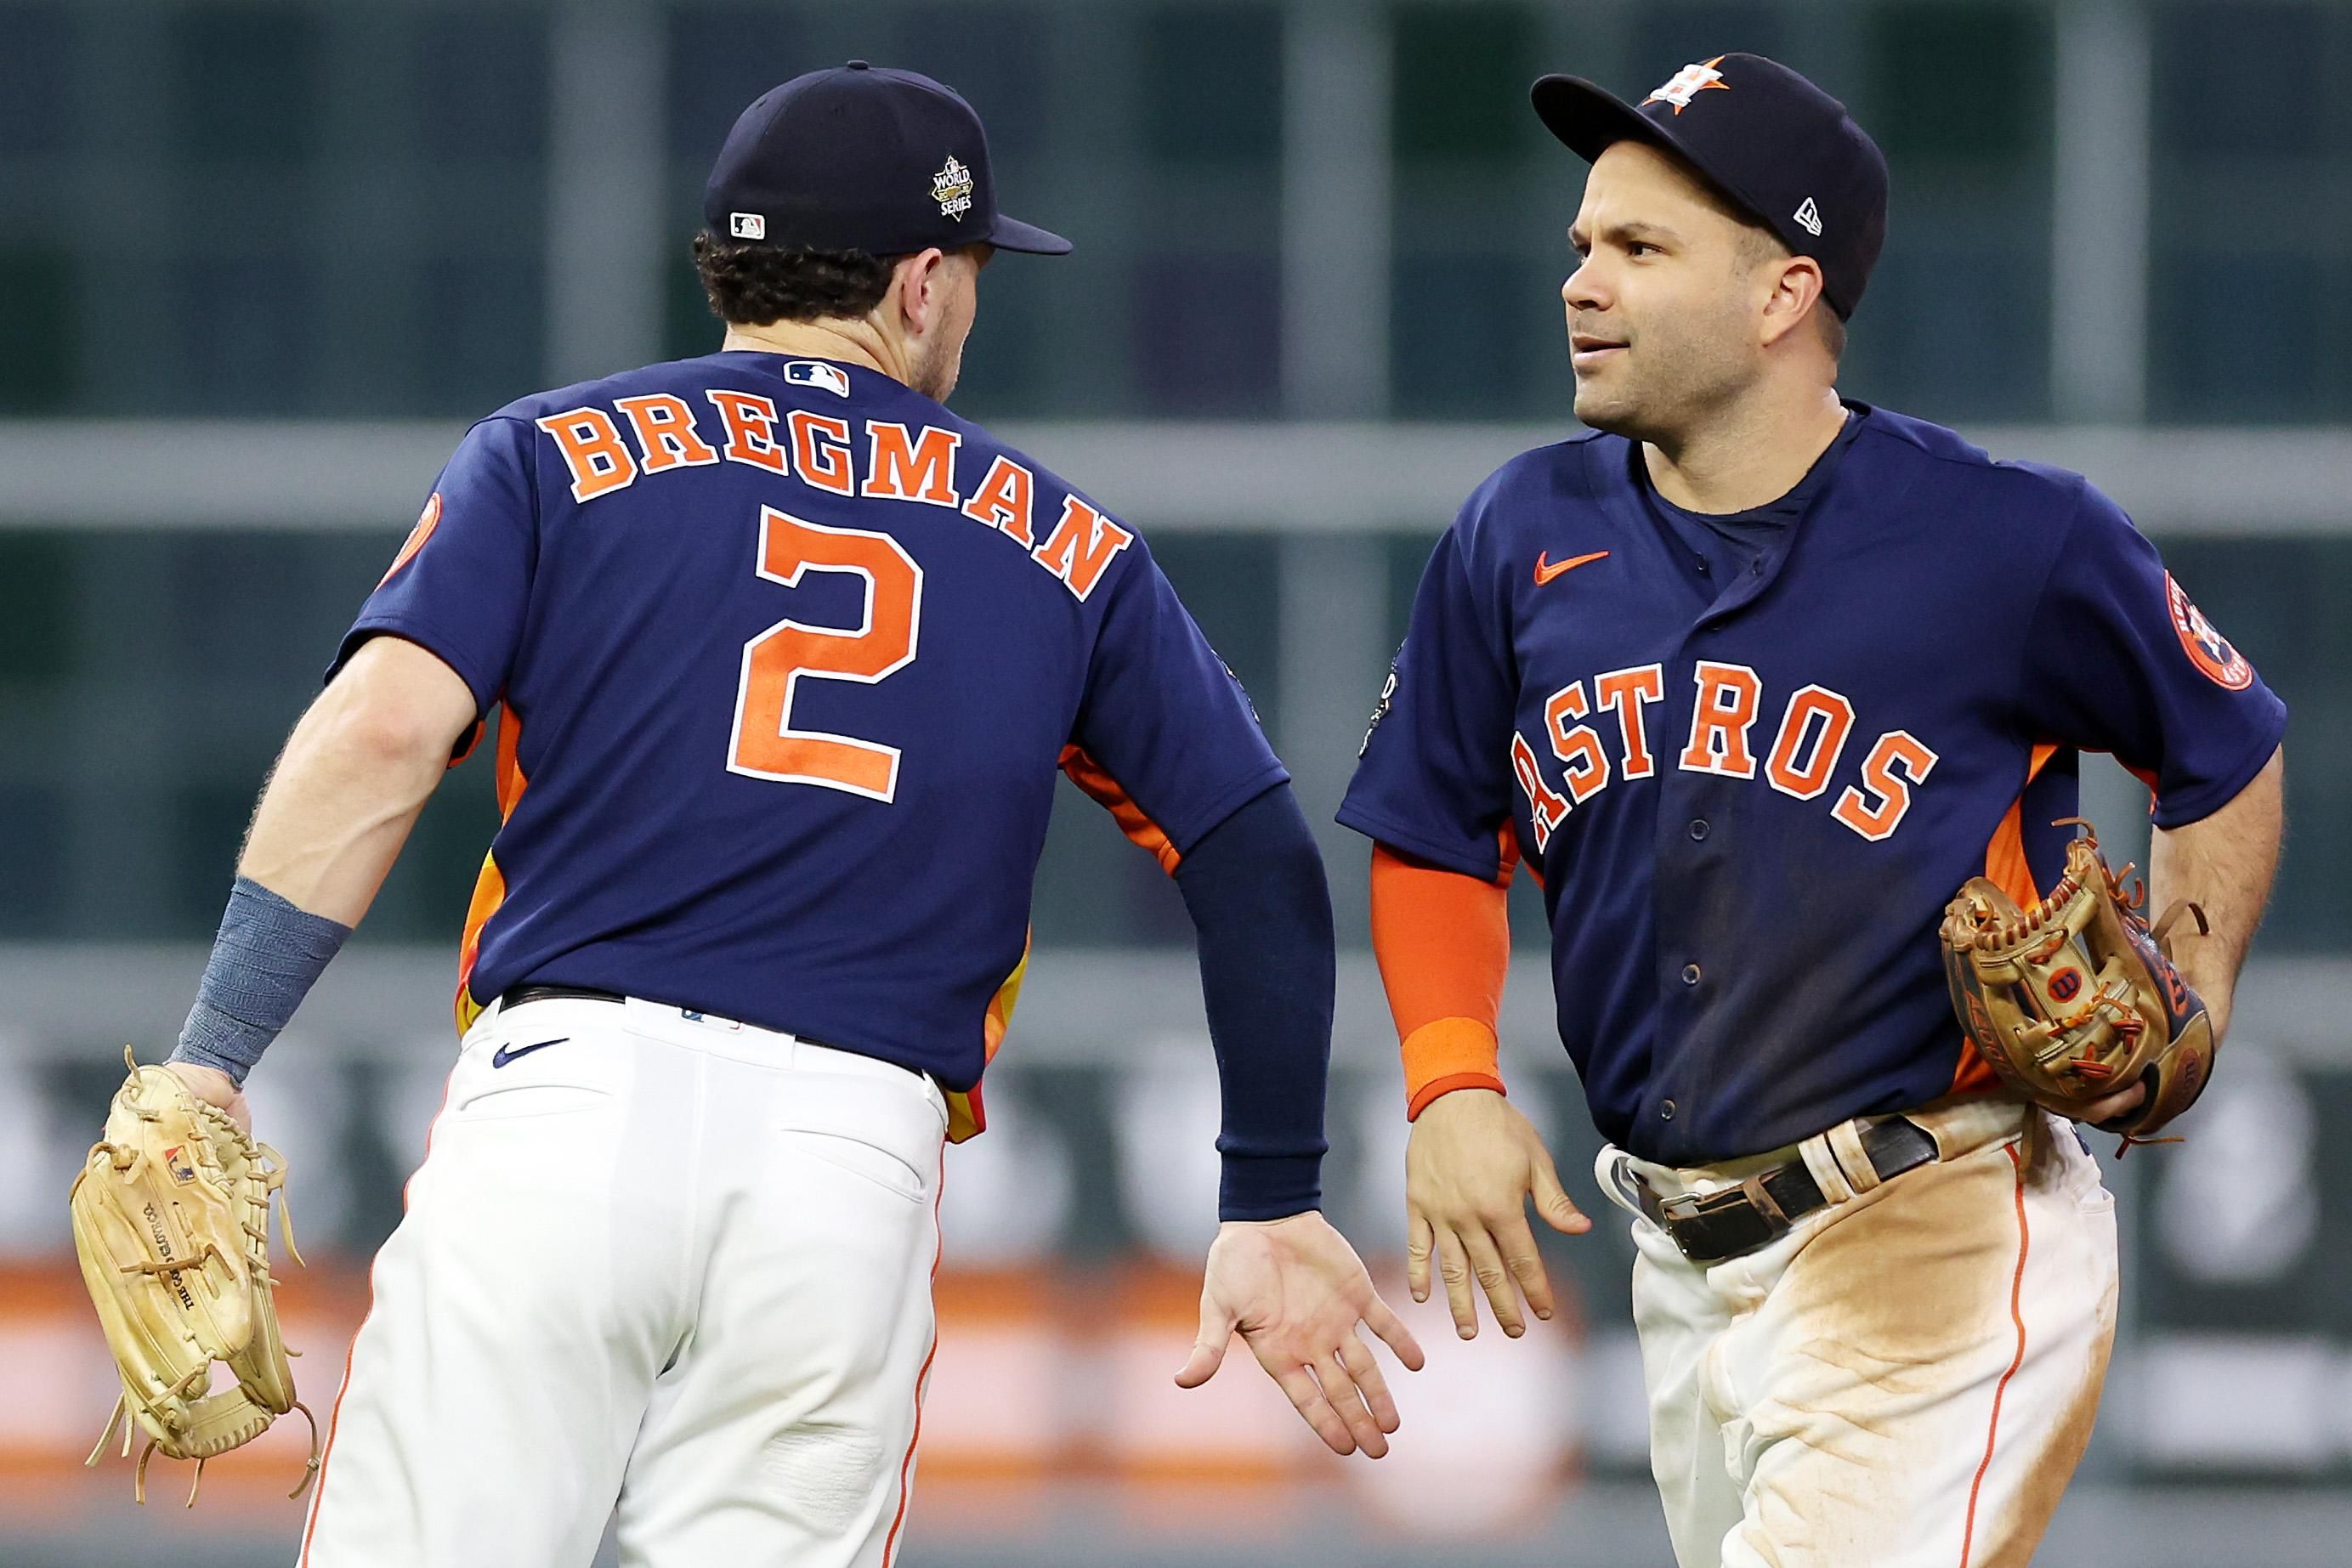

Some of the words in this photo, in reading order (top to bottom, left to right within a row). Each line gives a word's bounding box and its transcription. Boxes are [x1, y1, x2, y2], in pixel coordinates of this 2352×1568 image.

[933, 169, 970, 190] WORLD
[941, 195, 972, 216] SERIES
[536, 389, 1134, 603] BREGMAN
[726, 504, 924, 804] 2
[1510, 660, 1939, 855] ASTROS
